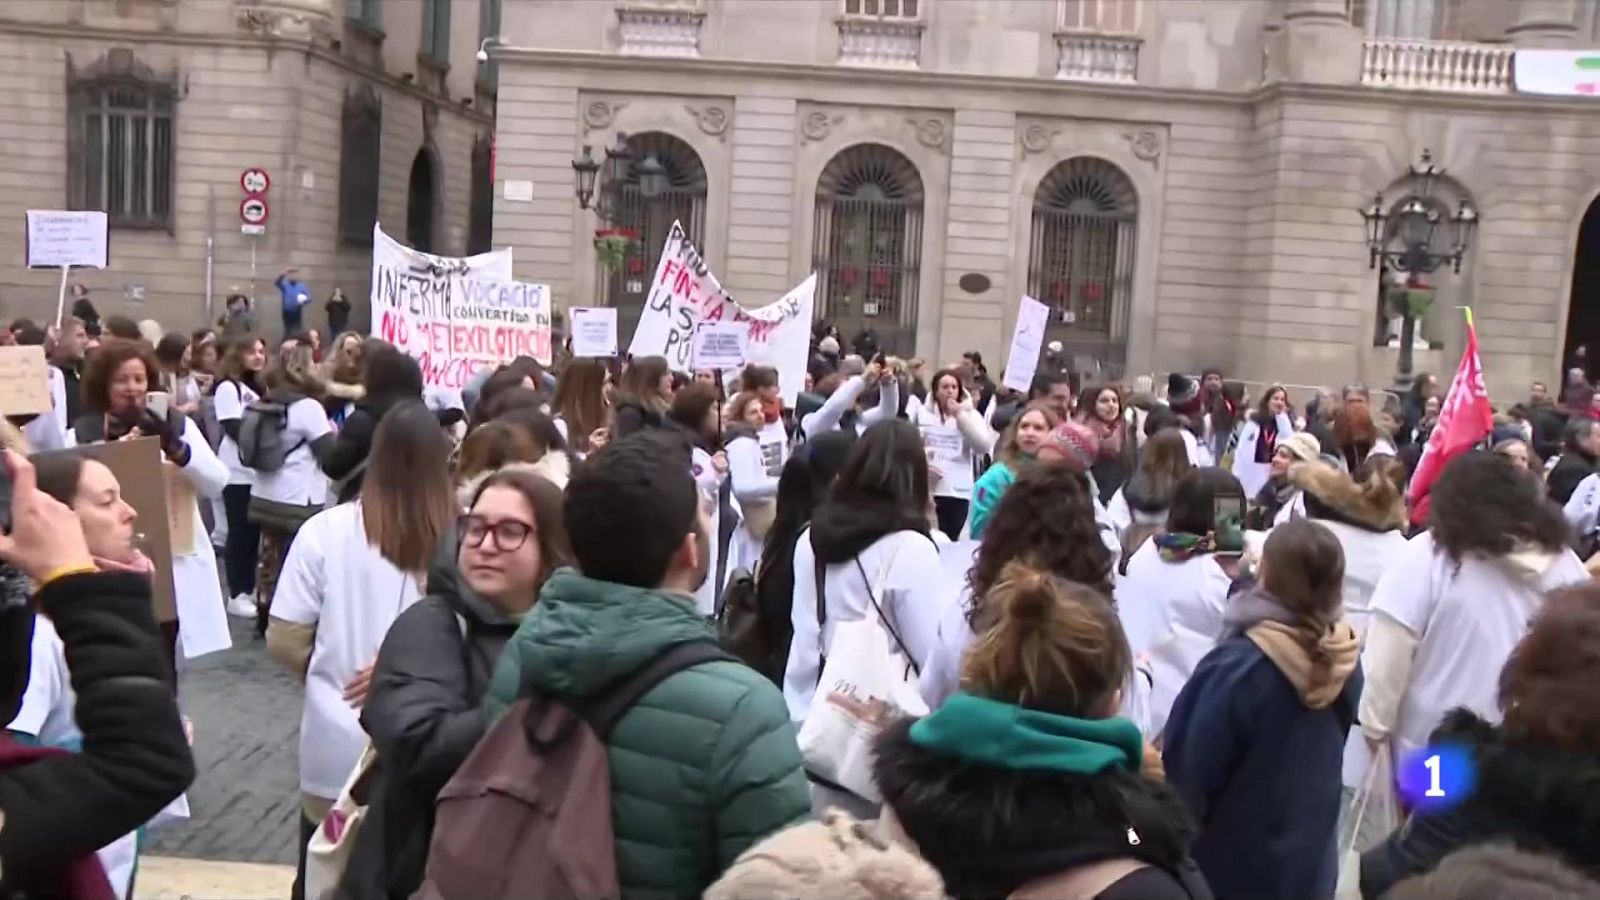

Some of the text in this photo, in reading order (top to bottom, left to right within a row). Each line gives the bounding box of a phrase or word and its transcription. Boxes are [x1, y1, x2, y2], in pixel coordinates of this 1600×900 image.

[382, 310, 409, 346] NO
[650, 289, 698, 331] LA S
[664, 327, 694, 367] PÚ
